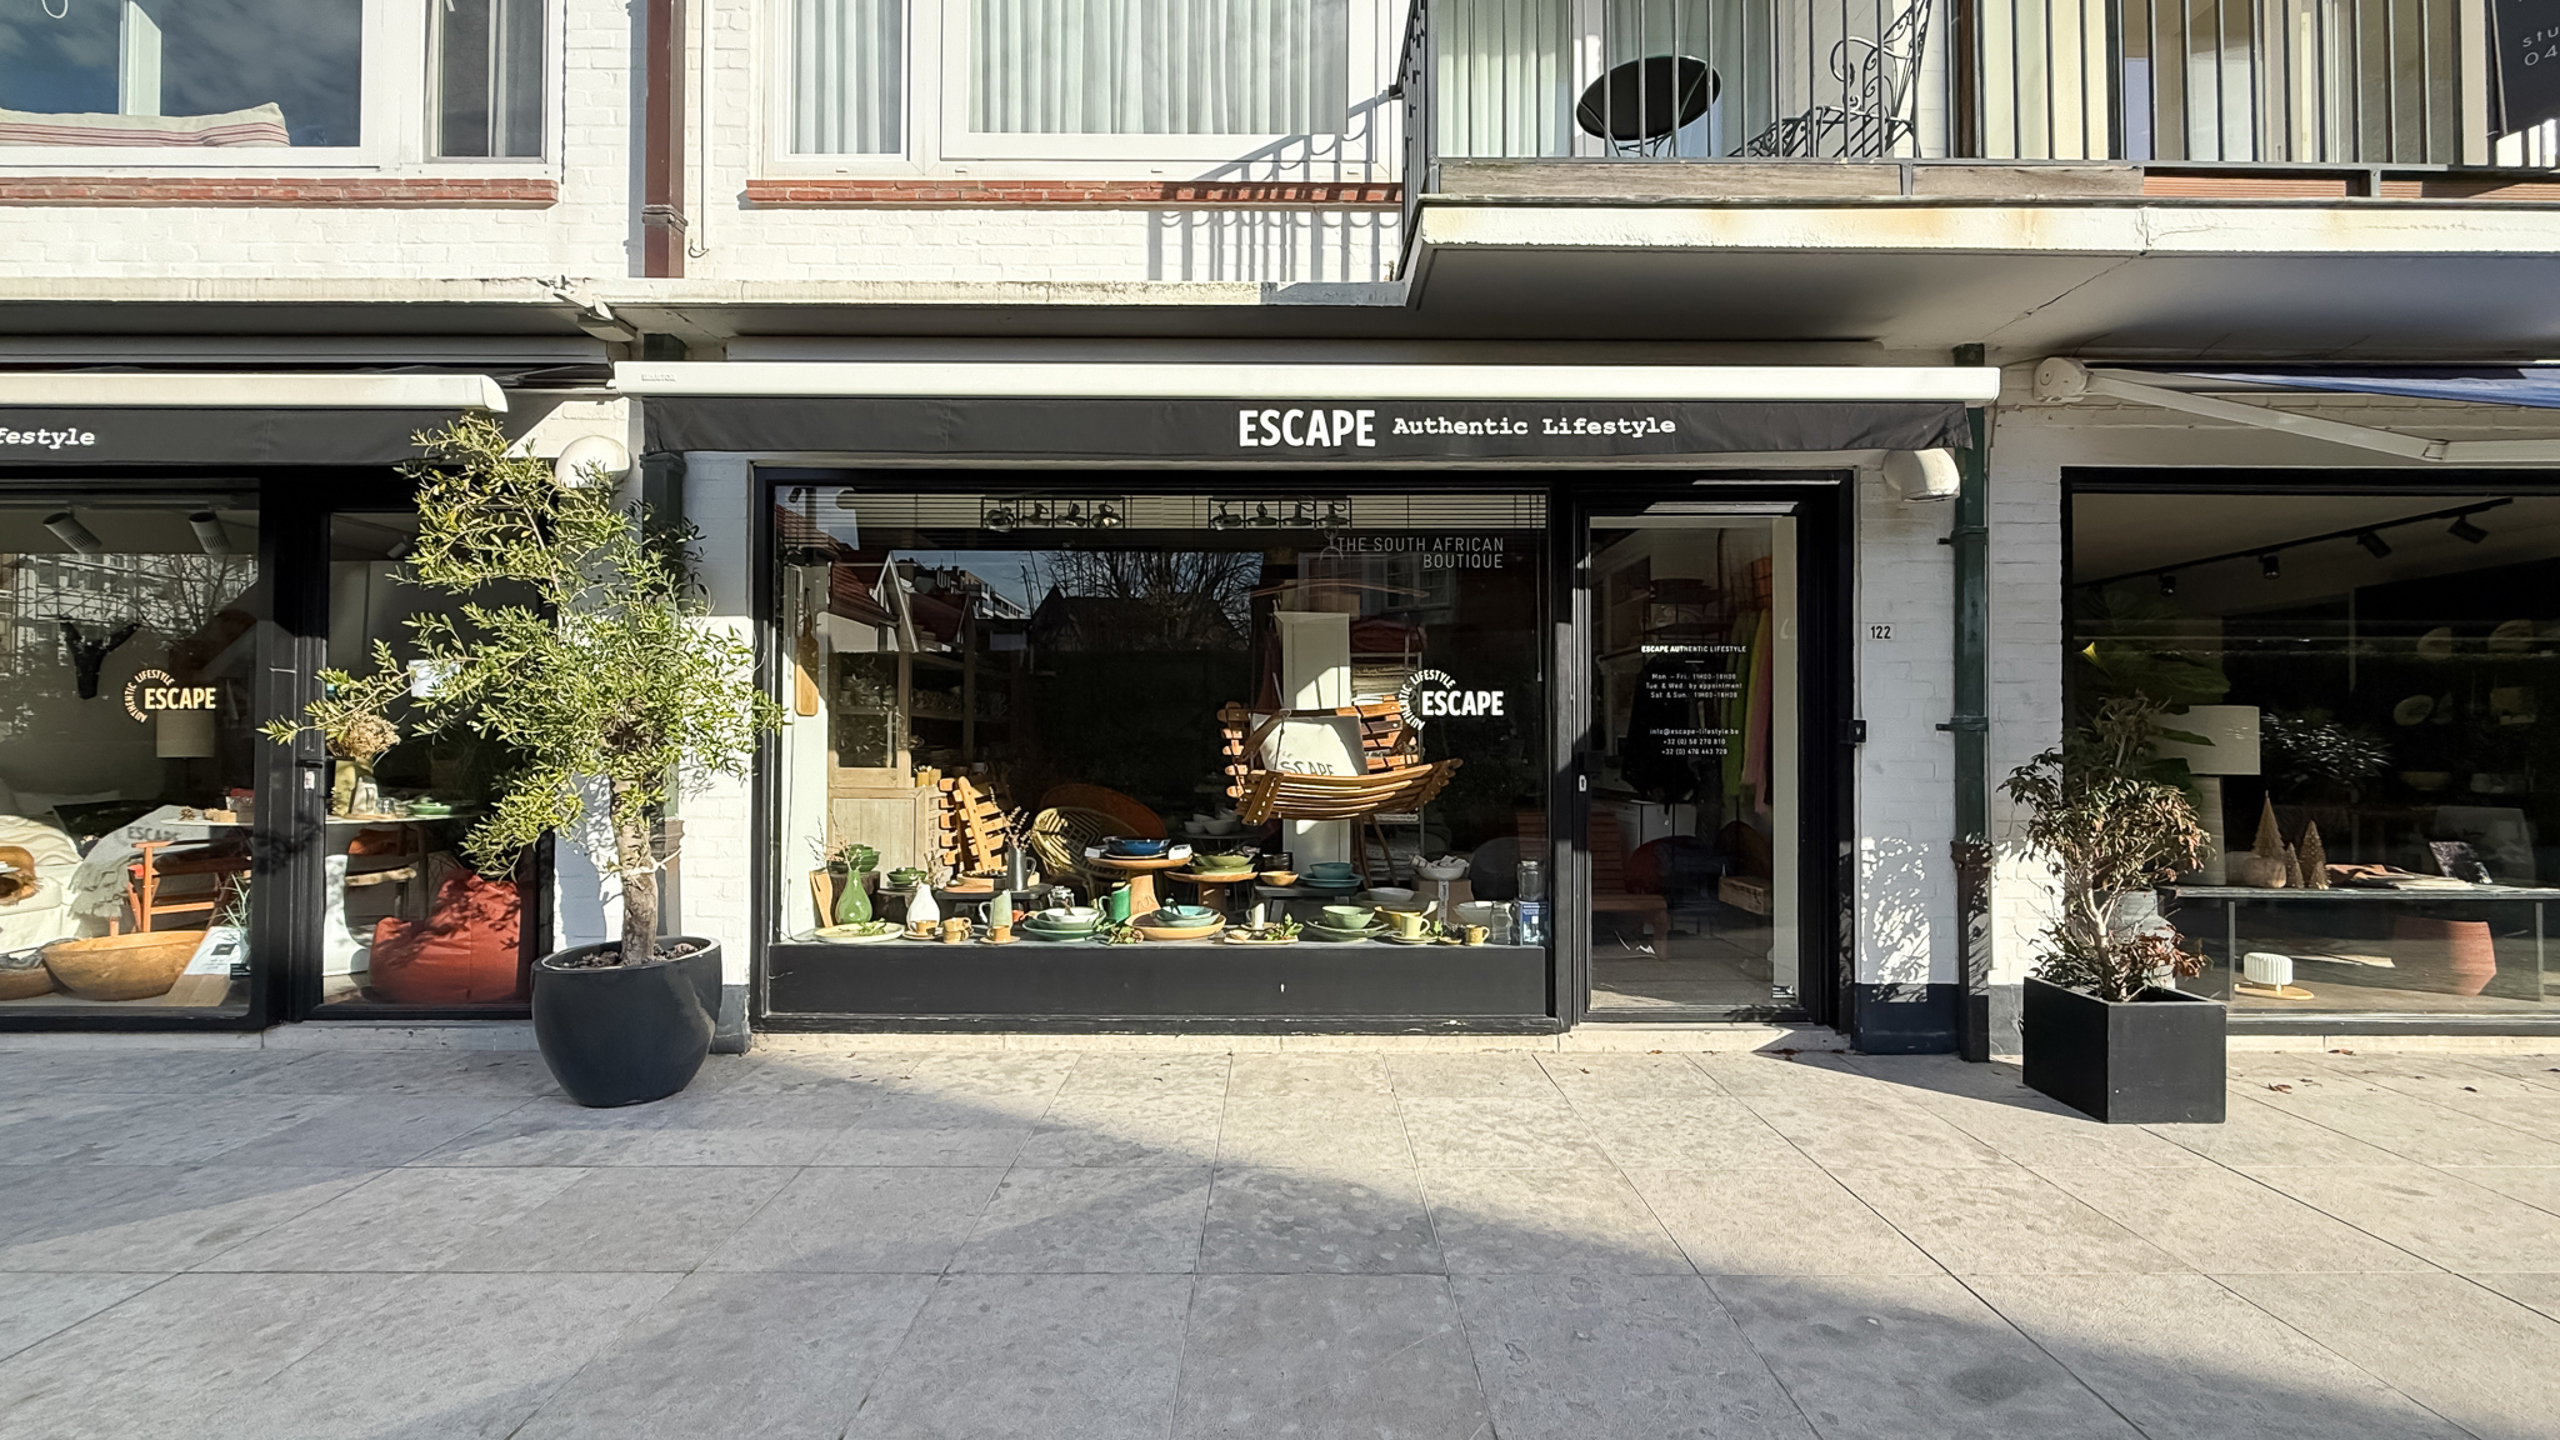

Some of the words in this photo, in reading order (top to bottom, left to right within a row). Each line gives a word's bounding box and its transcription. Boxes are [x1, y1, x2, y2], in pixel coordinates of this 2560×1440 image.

[1239, 408, 1376, 447] ESCAPE
[1392, 416, 1529, 435] Authentic
[1542, 417, 1677, 438] Lifestyle
[1337, 537, 1367, 551] THE
[1373, 537, 1425, 551] SOUTH
[1433, 537, 1503, 551] AFRICAN
[1424, 554, 1503, 568] BOUTIQUE
[1870, 625, 1891, 640] 122
[1641, 645, 1669, 653] ESCAPE
[1669, 645, 1708, 653] AUTHENTIC
[1709, 645, 1747, 653] LIFESTYLE
[134, 669, 176, 687] LIFESTYLE
[1409, 669, 1457, 690] LIFESTYLE
[1688, 682, 1697, 690] by
[124, 681, 149, 724] AUTHENTIC
[144, 687, 217, 709] ESCAPE
[1421, 690, 1505, 717] ESCAPE
[1398, 683, 1426, 731] AUTHENTIC
[1649, 728, 1739, 736] info@escape-lifestyle.be
[1663, 738, 1675, 746] +32
[1677, 738, 1687, 746] (0)
[1661, 748, 1674, 756] +32
[1675, 748, 1686, 756] (0)
